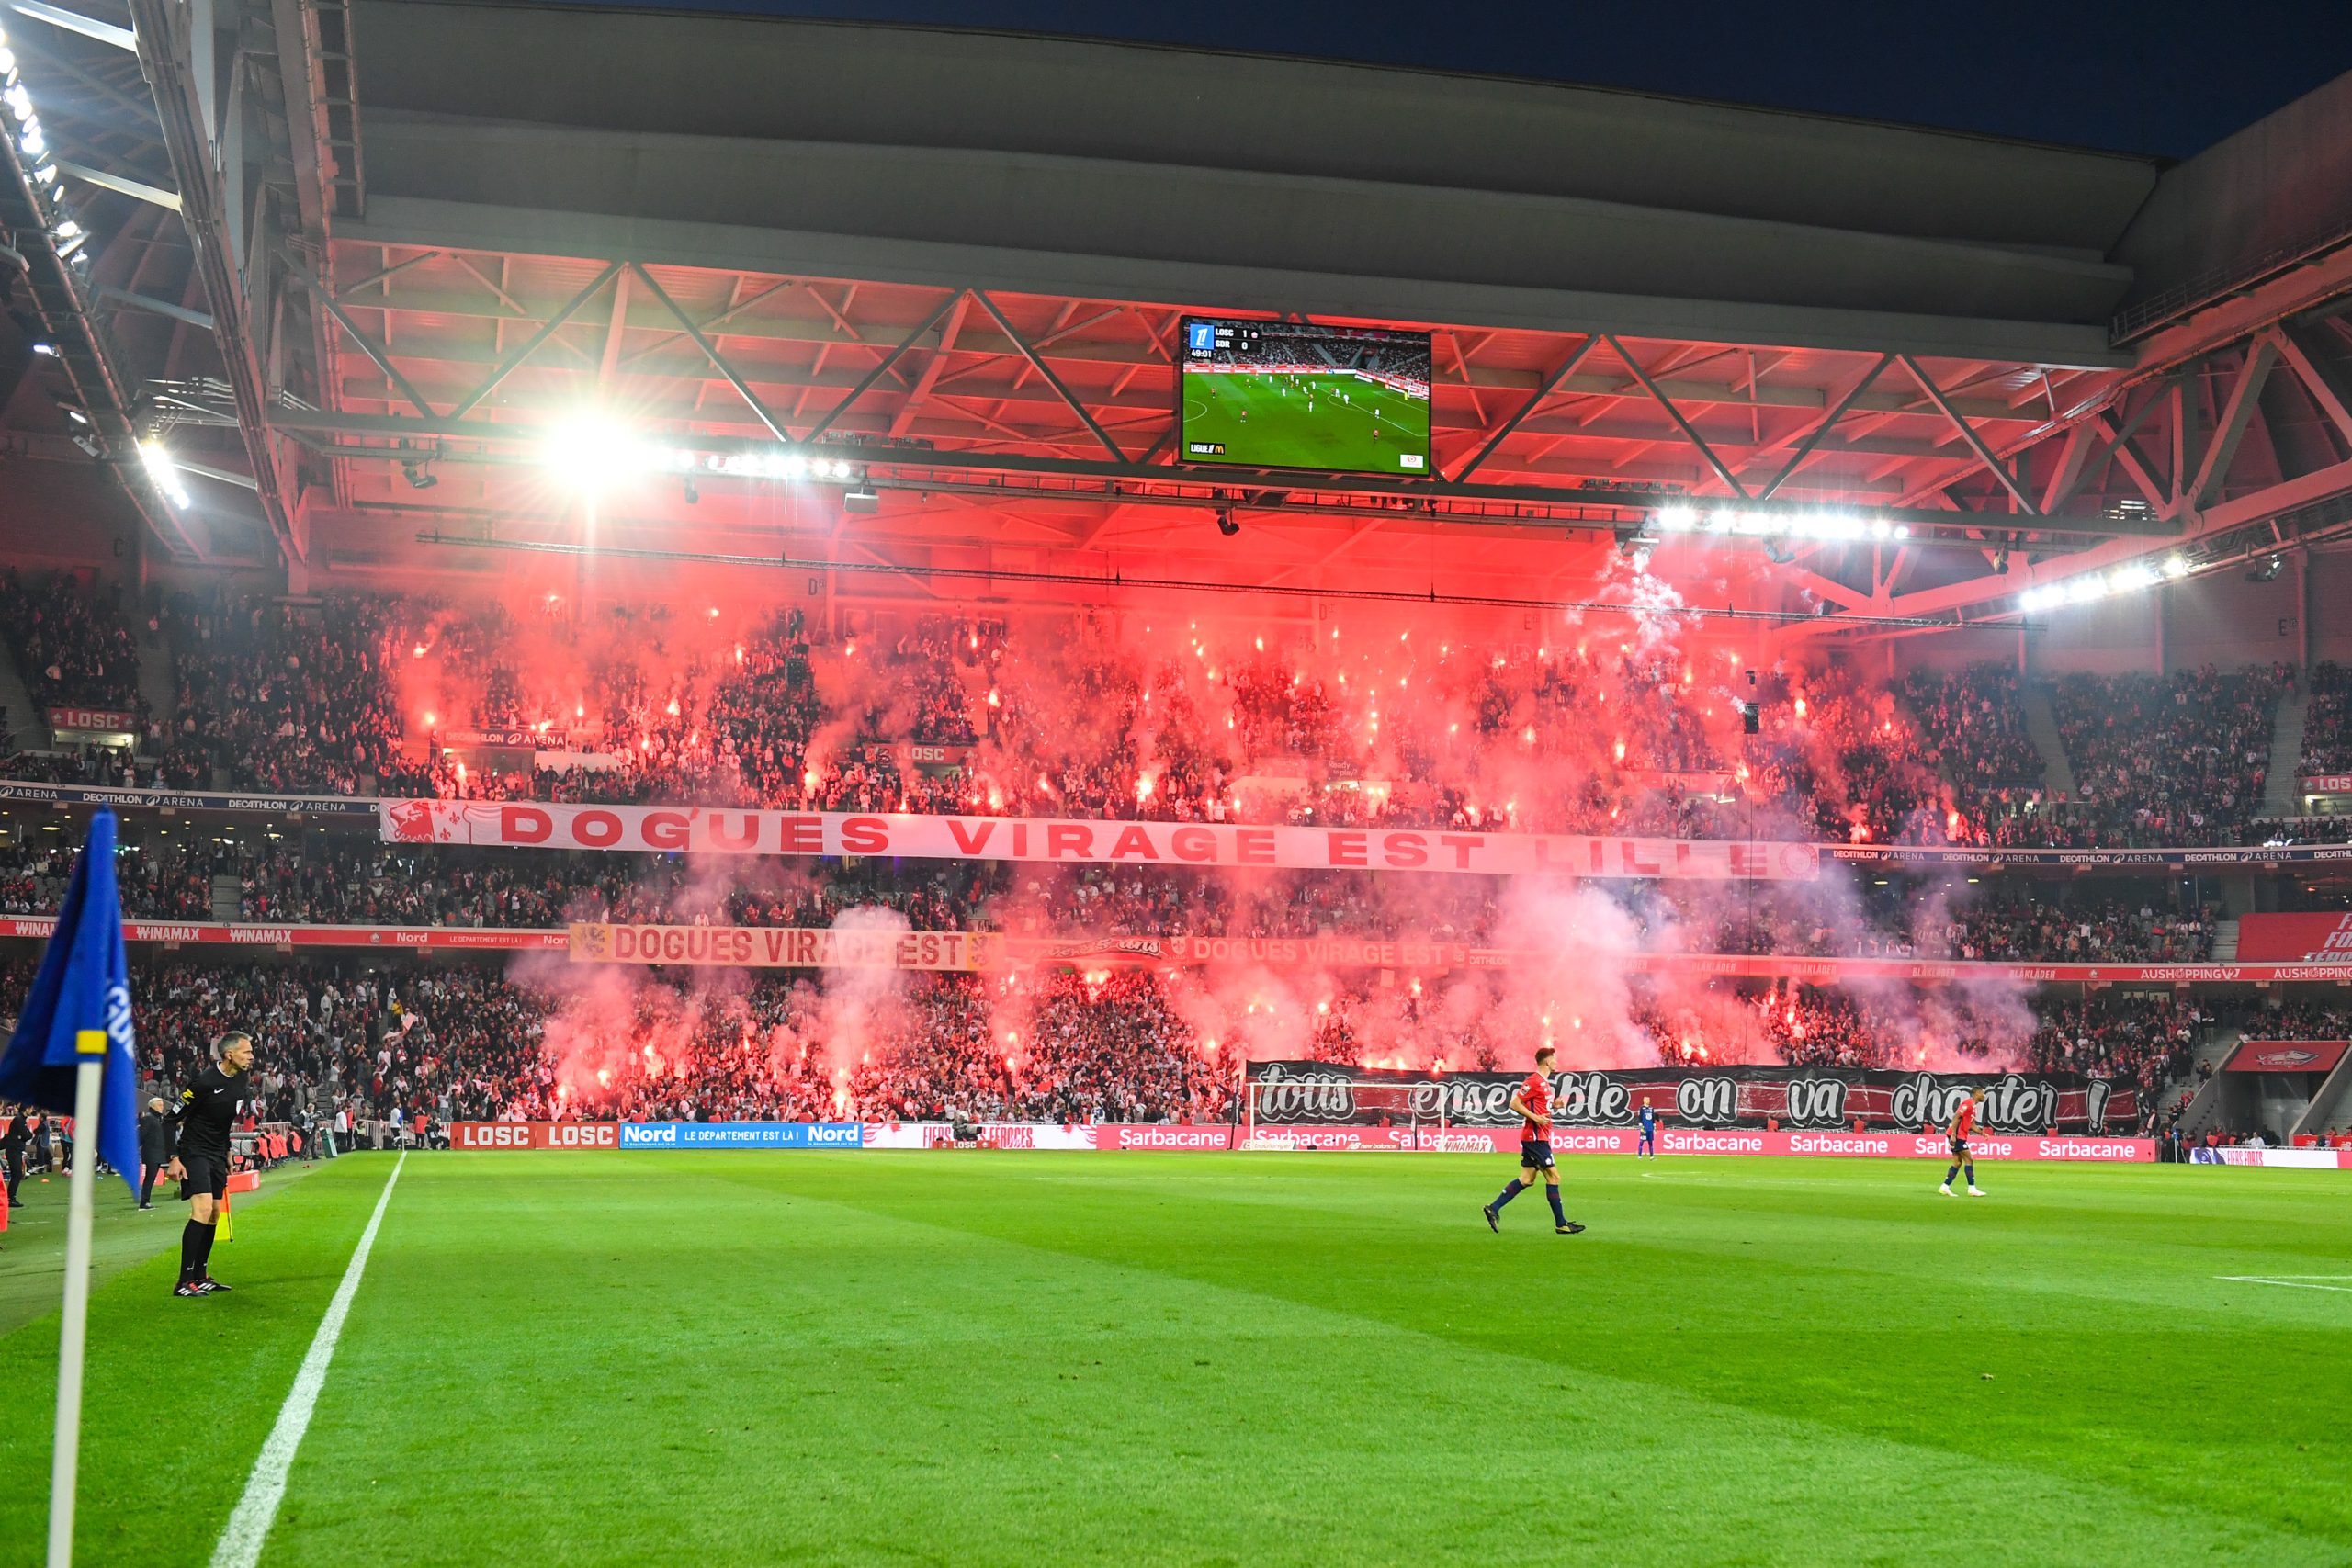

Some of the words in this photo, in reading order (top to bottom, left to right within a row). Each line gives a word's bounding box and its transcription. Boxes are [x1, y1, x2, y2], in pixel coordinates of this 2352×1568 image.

[1216, 328, 1234, 336] LOSC
[1243, 330, 1247, 338] 1
[1241, 342, 1248, 350] 0
[1191, 444, 1208, 453] LIGUE
[67, 711, 119, 729] LOSC
[524, 735, 564, 745] ARENA
[2320, 778, 2352, 790] LOS
[16, 786, 58, 800] ARENA
[83, 792, 142, 805] DECATHLON
[163, 795, 204, 807] ARENA
[229, 798, 287, 810] DECATHLON
[306, 801, 346, 812] ARENA
[501, 806, 888, 853] DOGUES
[947, 819, 1276, 863] VIRAGE
[1328, 832, 1484, 869] EST
[1833, 850, 1878, 860] DECATHLON
[1893, 852, 1925, 861] ARENA
[1942, 853, 1989, 863] DECATHLON
[2006, 854, 2040, 863] ARENA
[2060, 854, 2110, 863] DECATHLON
[2127, 854, 2164, 863] ARENA
[2185, 853, 2237, 862] DECATHLON
[2255, 852, 2292, 861] ARENA
[2314, 850, 2352, 859] DECATHL
[137, 926, 199, 941] WINAMAX
[230, 928, 291, 942] WINAMAX
[396, 931, 428, 942] Nord
[616, 925, 752, 961] DOGUES
[765, 929, 888, 964] VIRAGE
[898, 933, 963, 965] EST
[1119, 940, 1159, 953] ans
[1194, 941, 1297, 962] DOGUES
[1305, 942, 1395, 964] VIRAGE
[1402, 944, 1446, 964] EST
[1470, 956, 1512, 965] CATHLON
[1259, 1064, 1354, 1119] tous
[1412, 1074, 1629, 1120] enseble
[1679, 1080, 1733, 1116] on
[1790, 1080, 1840, 1121] va
[2086, 1084, 2107, 1131] !
[464, 1126, 529, 1145] LOSC
[549, 1126, 614, 1145] LOSC
[624, 1124, 676, 1142] Nord
[684, 1131, 695, 1141] LE
[699, 1130, 761, 1141] DÉPARTEMENT
[763, 1131, 780, 1141] EST
[782, 1130, 794, 1141] LÀ
[808, 1124, 859, 1142] Nord
[1119, 1128, 1226, 1146] Sarbacane
[1255, 1129, 1360, 1146] Sarbacane
[1389, 1131, 1491, 1147] Sarbacane
[1550, 1132, 1621, 1149] bacane
[953, 1140, 977, 1148] LOSC
[1444, 1141, 1487, 1152] WINAMAX
[1663, 1133, 1762, 1151] Sarbacane
[1790, 1135, 1888, 1154] Sarbacane
[1915, 1137, 2012, 1156] Sarbcane
[2039, 1140, 2136, 1158] Sarbacane
[2227, 1150, 2243, 1166] FIERS
[2245, 1150, 2264, 1167] FORTS
